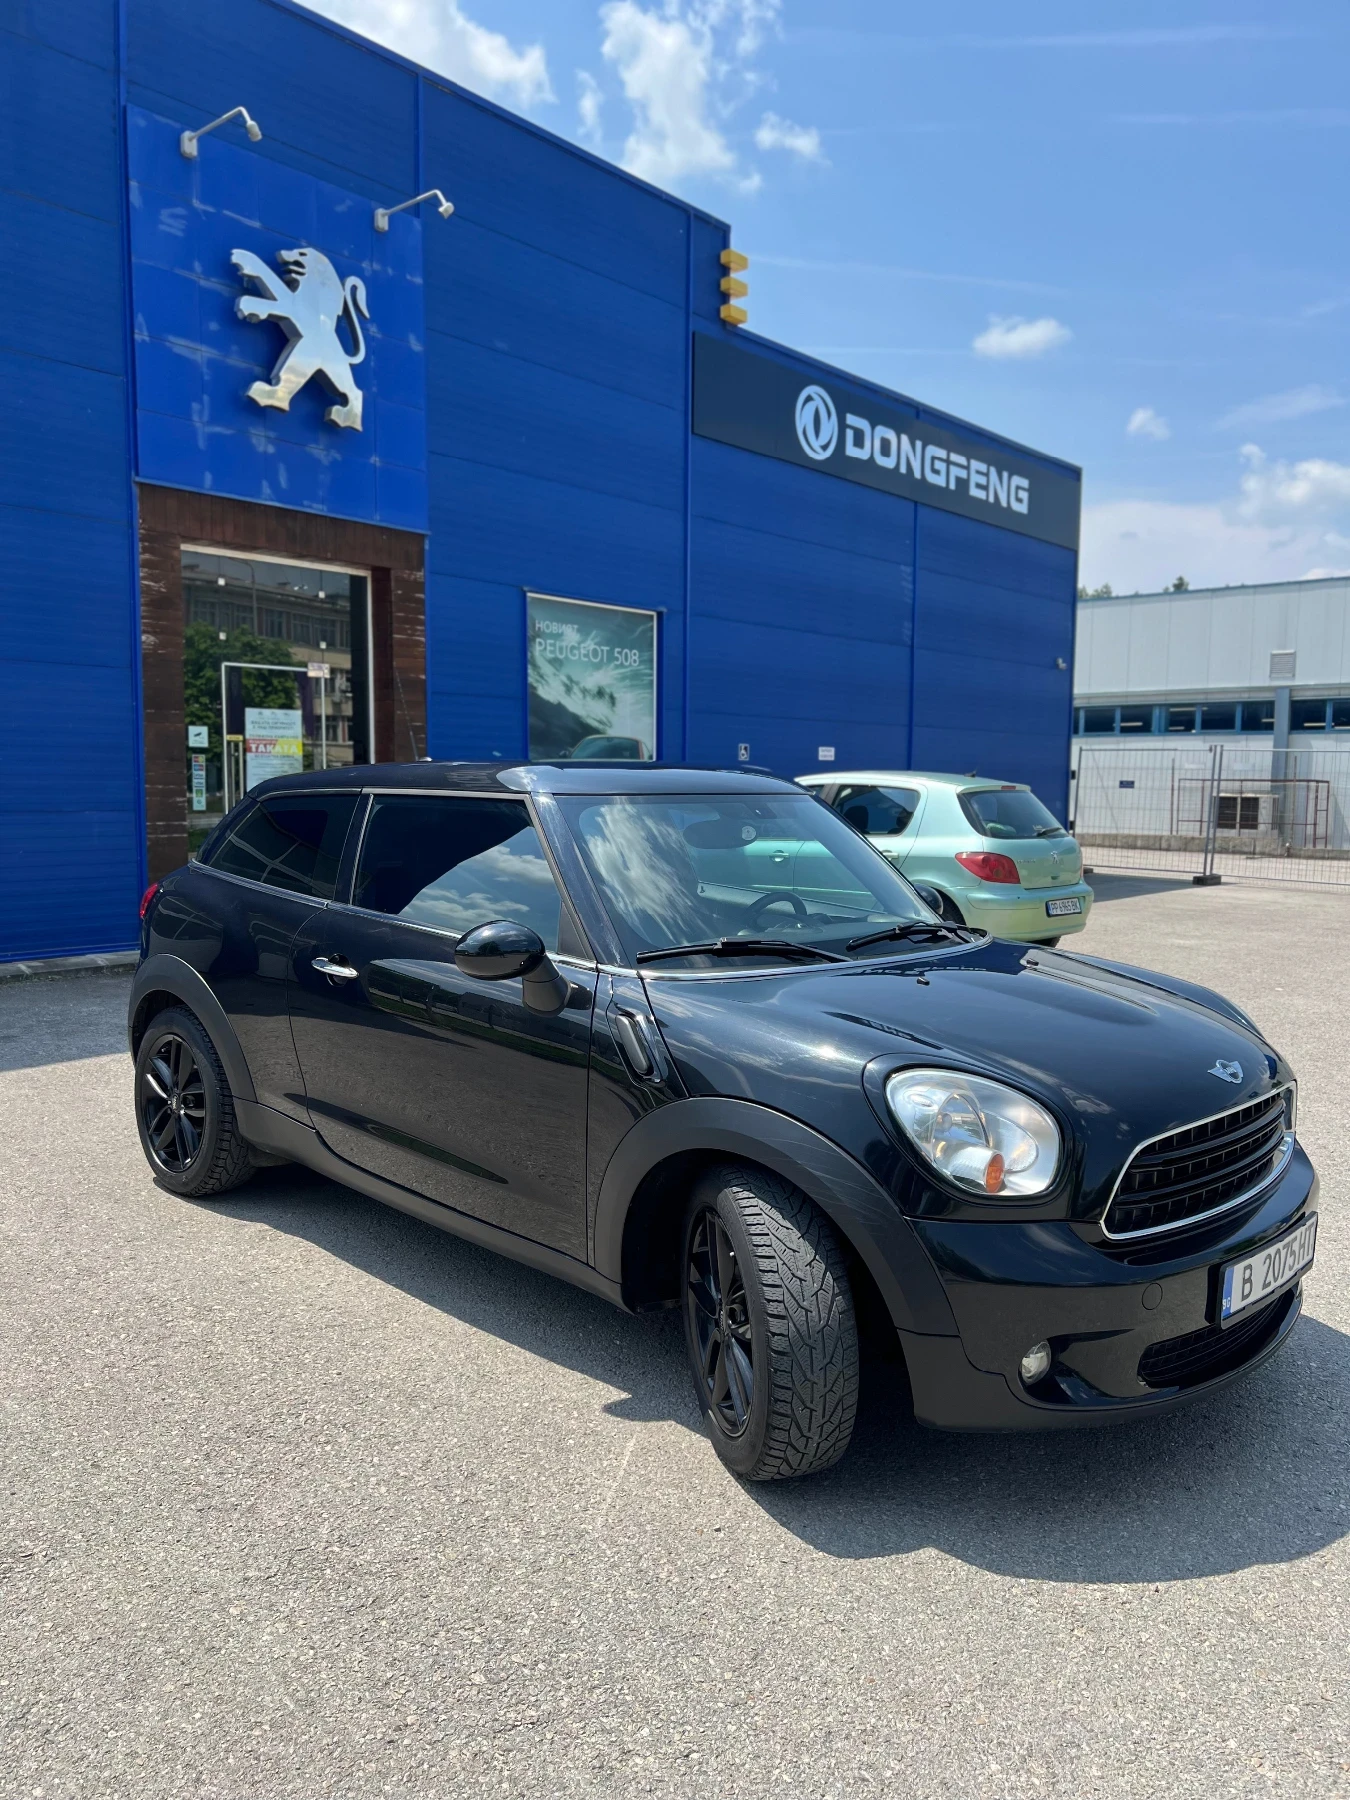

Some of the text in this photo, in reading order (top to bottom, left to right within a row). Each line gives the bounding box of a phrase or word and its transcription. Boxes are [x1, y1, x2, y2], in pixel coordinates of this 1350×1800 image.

[845, 412, 1030, 515] DONGFENG
[535, 637, 640, 667] PEUGEOT 508
[249, 743, 299, 754] TAKATA
[1241, 1263, 1253, 1302] B
